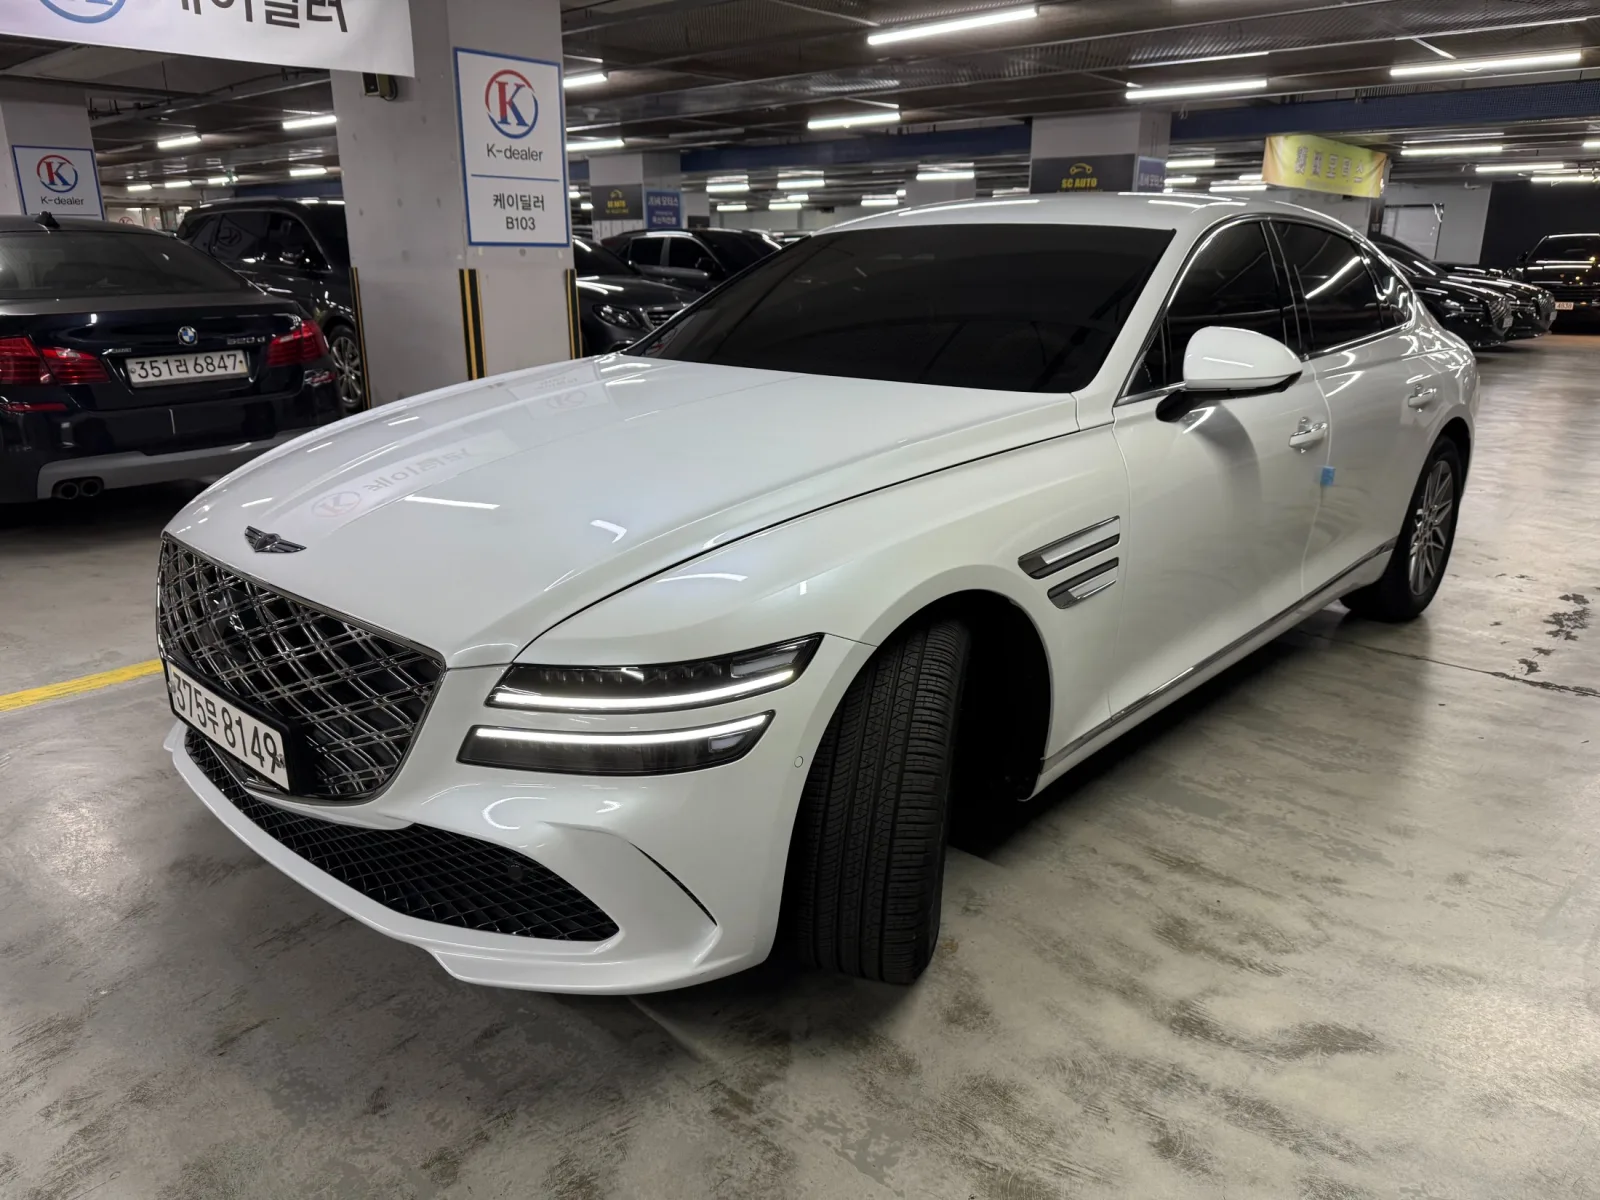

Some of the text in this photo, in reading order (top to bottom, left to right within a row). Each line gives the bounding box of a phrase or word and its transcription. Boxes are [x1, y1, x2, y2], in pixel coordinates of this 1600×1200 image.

[487, 143, 543, 161] K-dealer
[1075, 178, 1098, 188] AUTO
[40, 196, 84, 206] K-dealer
[493, 193, 545, 211] 케이딜러
[506, 217, 536, 231] B103
